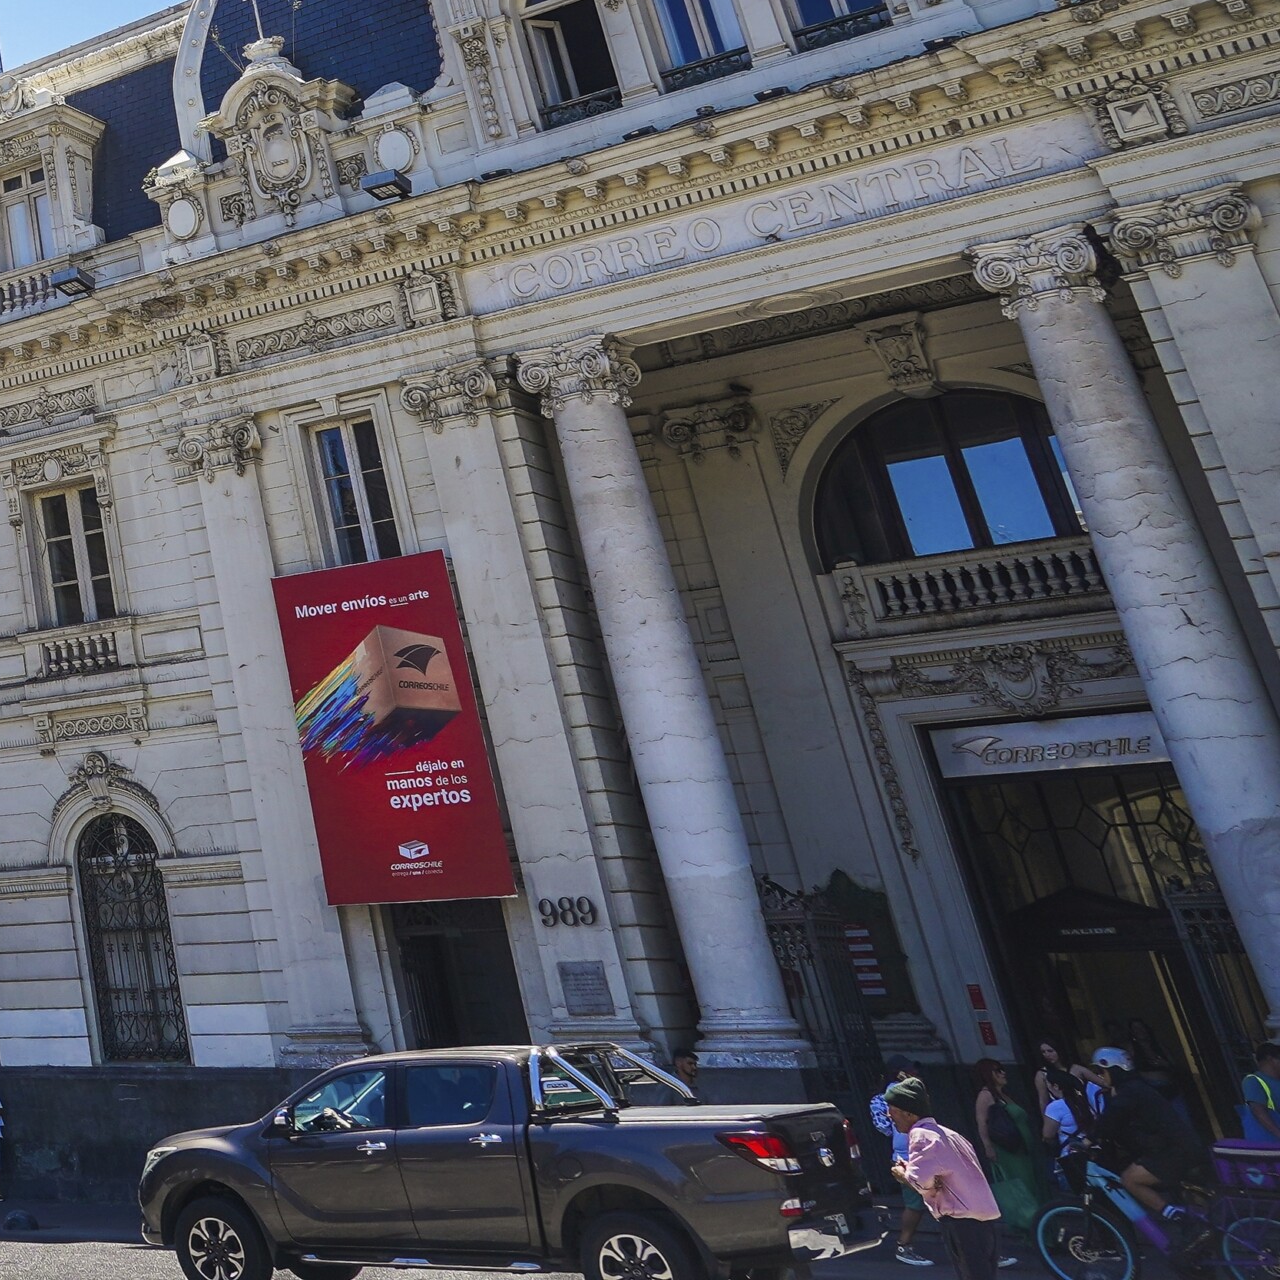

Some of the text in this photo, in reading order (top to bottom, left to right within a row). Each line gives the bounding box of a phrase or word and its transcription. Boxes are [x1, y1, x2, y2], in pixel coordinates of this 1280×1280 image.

[508, 137, 1045, 298] CORREO CENTRAL
[295, 603, 338, 618] Mover
[341, 595, 387, 611] envíos
[398, 595, 408, 603] un
[408, 590, 429, 601] arte
[399, 680, 449, 691] CORREOSCHILE
[983, 735, 1151, 765] CORREOSCHILE
[416, 760, 464, 773] déjalo en
[387, 774, 468, 790] manos de los
[390, 789, 471, 811] expertos
[391, 860, 443, 870] CORREOSCHILE
[538, 896, 596, 928] 989
